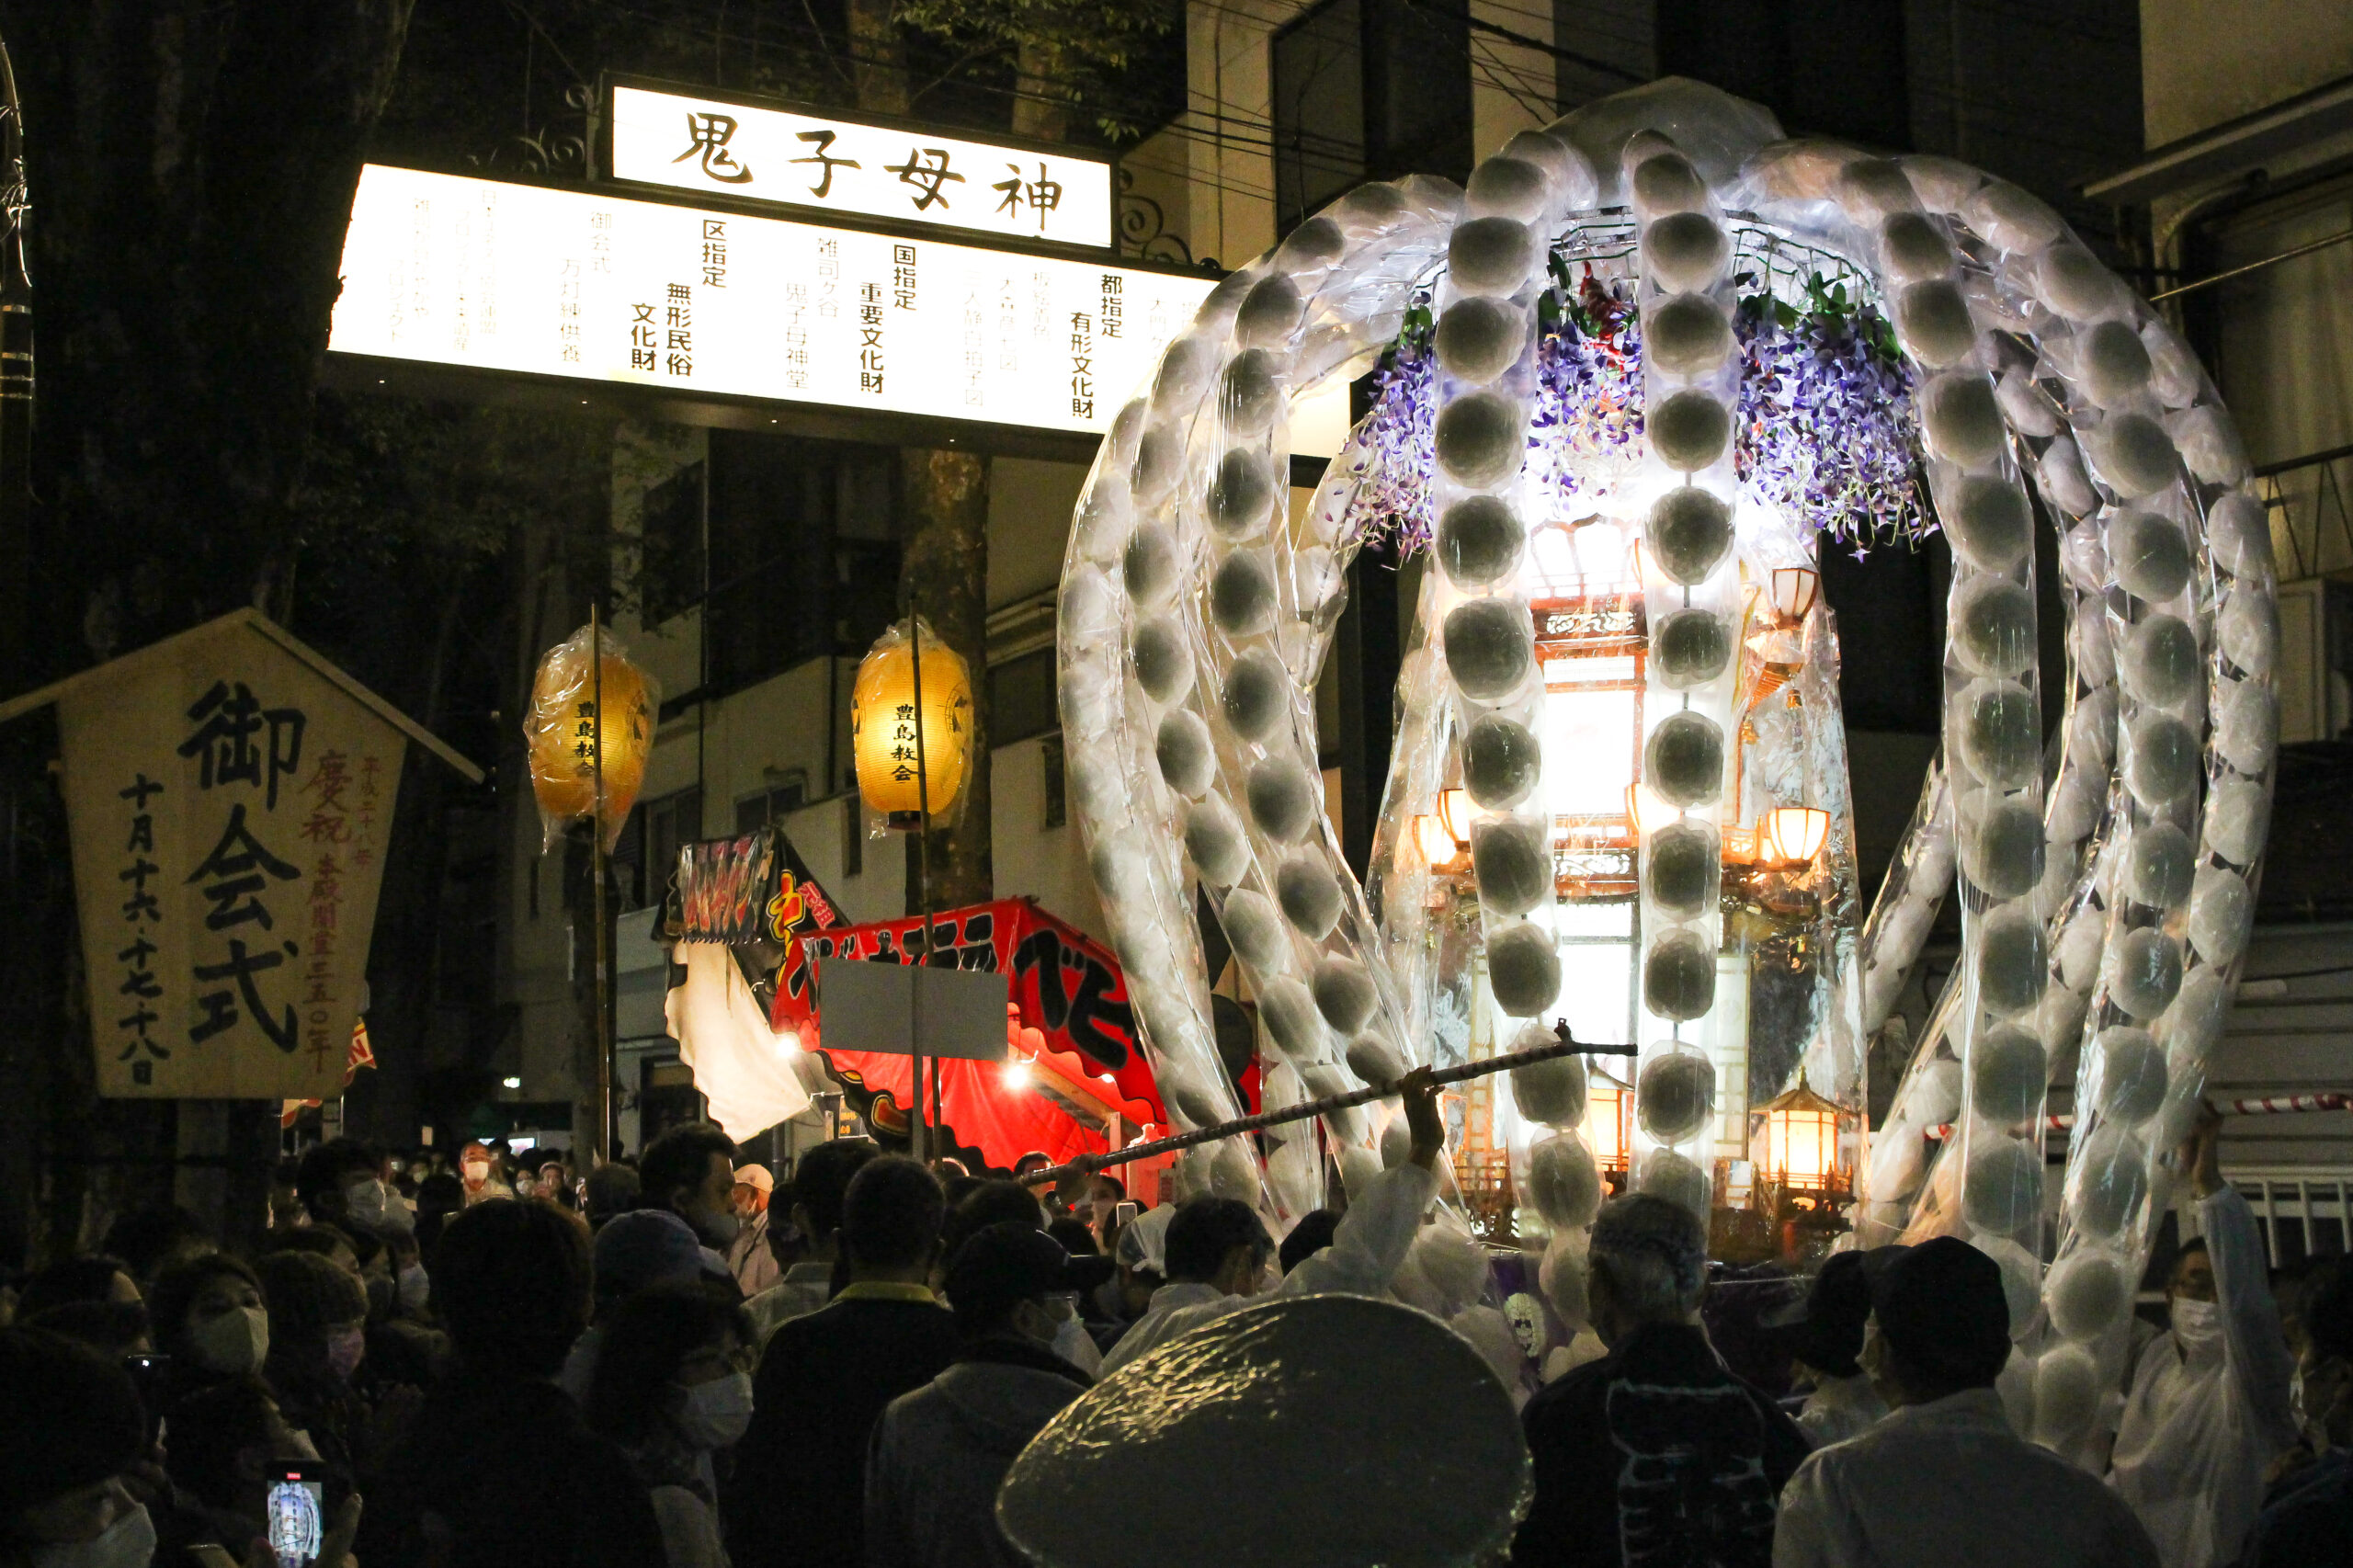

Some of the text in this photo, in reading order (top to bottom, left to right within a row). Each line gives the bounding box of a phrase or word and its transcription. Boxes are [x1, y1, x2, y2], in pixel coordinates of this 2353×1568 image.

[671, 111, 1063, 233] 鬼子母神
[589, 210, 613, 274] 御会式
[701, 219, 728, 289] 区指定
[892, 244, 917, 312] 国指定
[559, 257, 582, 363] 万灯練供養
[630, 302, 657, 372] 文化財
[665, 281, 693, 377] 無形民俗
[785, 281, 810, 390] 鬼子母神堂
[859, 281, 885, 395] 重要文化財
[1100, 273, 1124, 339] 都指定
[1070, 311, 1094, 420] 有形文化財
[890, 703, 919, 782] 豊島教会
[176, 679, 309, 1054] 御会式
